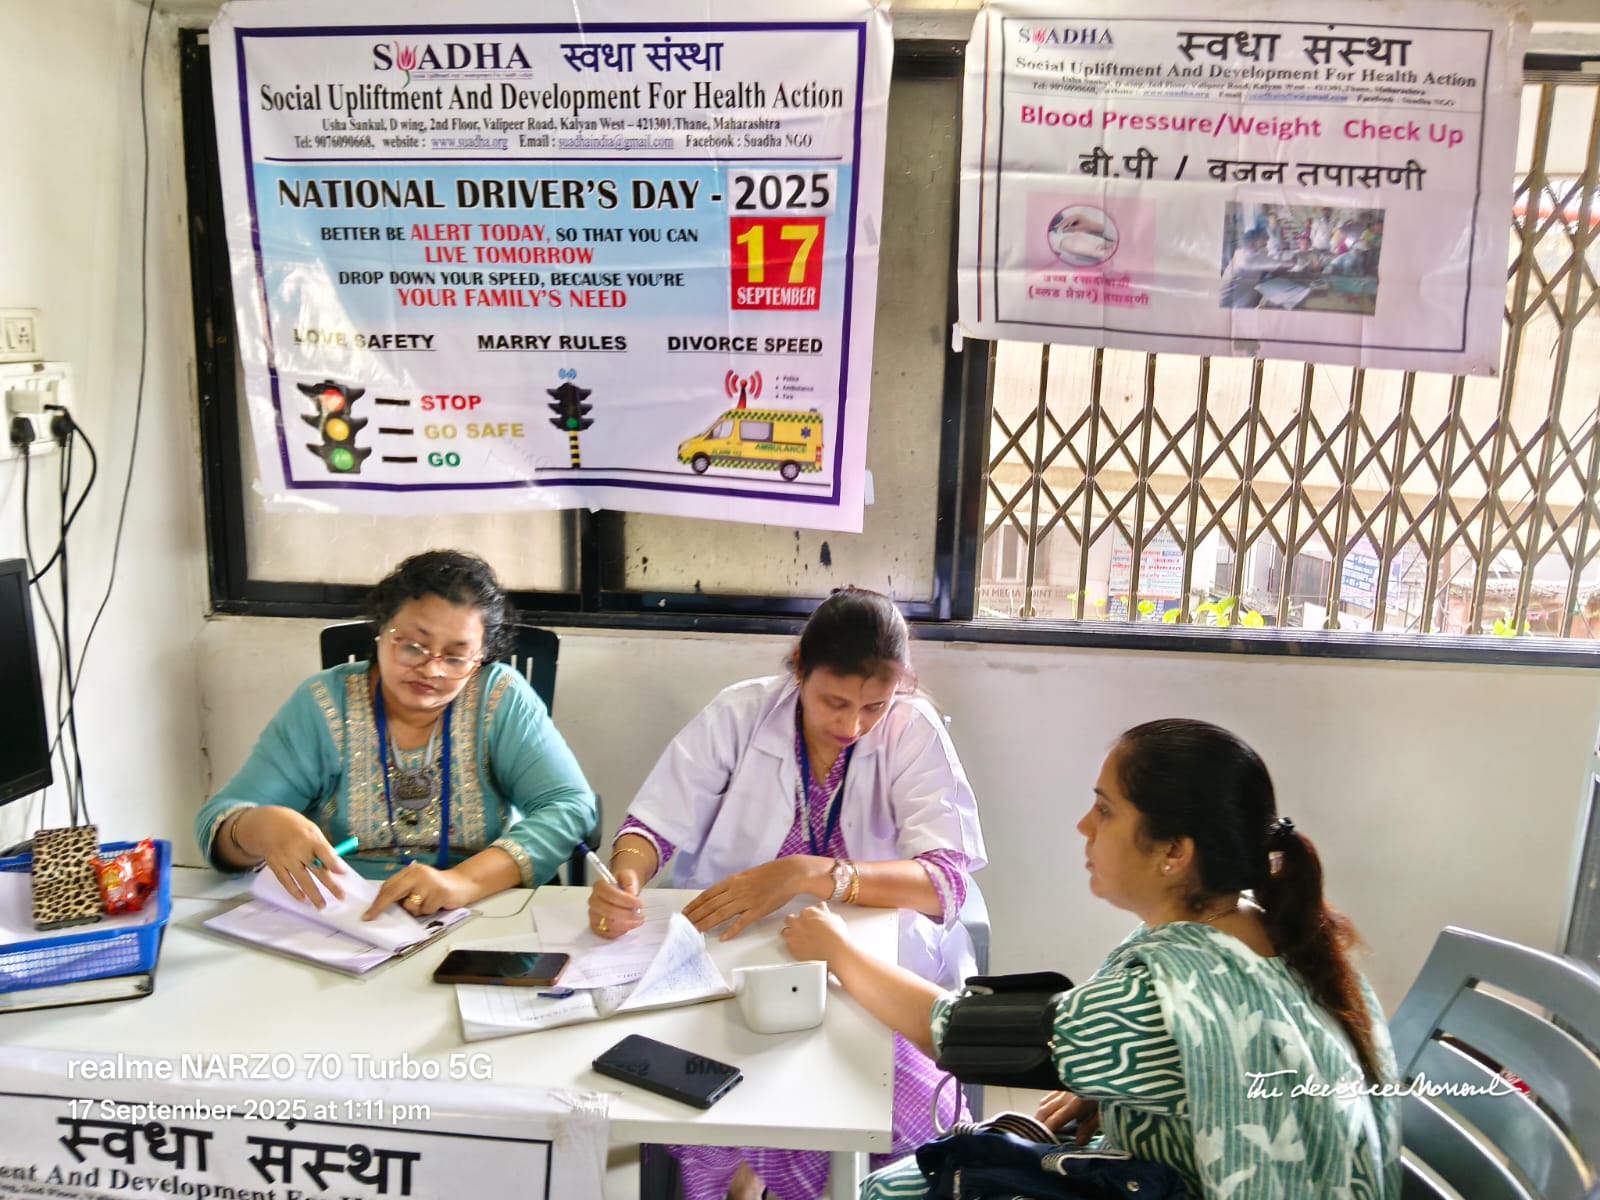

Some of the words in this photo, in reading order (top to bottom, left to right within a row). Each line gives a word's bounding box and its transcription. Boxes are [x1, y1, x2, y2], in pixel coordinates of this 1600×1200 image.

[560, 43, 636, 72] स्वधा
[643, 36, 724, 72] संस्था
[1177, 30, 1281, 62] स्वधा
[1303, 24, 1412, 67] संस्था
[1015, 56, 1064, 73] Social
[1070, 61, 1161, 79] Upliftment
[1167, 64, 1202, 78] And
[1209, 64, 1319, 82] Development
[1325, 68, 1354, 82] For
[1361, 69, 1417, 84] Health
[1422, 72, 1476, 88] Action
[260, 84, 322, 111] Social
[328, 83, 443, 117] Upliftment
[450, 83, 493, 110] And
[500, 82, 641, 116] Development
[650, 82, 687, 109] For
[693, 81, 766, 109] Health
[772, 81, 843, 108] Action
[322, 118, 347, 131] Usha
[350, 118, 387, 133] Sankul,
[390, 119, 398, 131] D
[400, 119, 427, 134] wing,
[430, 118, 449, 131] 2nd
[452, 118, 480, 132] Floor,
[483, 117, 523, 134] Valipeer
[528, 118, 557, 132] Road,
[560, 117, 597, 134] Kalyan
[600, 118, 624, 131] West
[713, 117, 780, 131] Maharashtra
[1020, 105, 1093, 128] Blood
[1102, 111, 1322, 141] Pressure/Weight
[1344, 119, 1421, 141] Check
[1428, 123, 1464, 148] Up
[295, 136, 313, 148] Tel:
[382, 136, 418, 148] website
[431, 136, 508, 150] www.suadha.org
[519, 135, 549, 148] Email
[686, 135, 733, 148] Facebook
[744, 135, 782, 148] Suadha
[785, 135, 812, 147] NGO
[1078, 146, 1159, 180] बी.पी
[1174, 155, 1189, 181] /
[1206, 158, 1289, 184] वजन
[1296, 158, 1427, 191] तपासणी
[278, 180, 446, 208] NATIONAL
[456, 180, 618, 209] DRIVER'S
[632, 180, 700, 209] DAY
[734, 174, 830, 210] 2025
[321, 227, 380, 241] BETTER
[386, 227, 405, 241] BE
[410, 224, 472, 241] ALERT
[477, 224, 551, 244] TODAY,
[556, 228, 577, 242] SO
[582, 228, 622, 242] THAT
[627, 228, 661, 242] YOU
[666, 228, 698, 243] CAN
[425, 246, 468, 263] LIVE
[474, 246, 595, 264] TOMORROW
[737, 224, 819, 284] 17
[339, 271, 384, 285] DROP
[390, 272, 435, 285] DOWN
[440, 272, 483, 285] YOUR
[488, 272, 545, 288] SPEED,
[551, 273, 621, 286] BECAUSE
[627, 273, 685, 287] YOU'RE
[398, 289, 456, 307] YOUR
[464, 289, 562, 308] FAMILY'S
[569, 290, 628, 308] NEED
[737, 286, 816, 306] SEPTEMBER
[294, 328, 348, 346] LOVE
[354, 334, 435, 349] SAFETY
[478, 335, 552, 349] MARRY
[559, 335, 628, 350] RULES
[667, 336, 758, 352] DIVORCE
[764, 337, 823, 353] SPEED
[421, 395, 482, 411] STOP
[424, 423, 458, 440] GO
[466, 422, 525, 439] SAFE
[427, 452, 461, 468] GO
[57, 1116, 213, 1172] स्वधा
[247, 1119, 420, 1197] संस्था
[46, 1164, 100, 1188] And
[110, 1167, 276, 1200] Development
